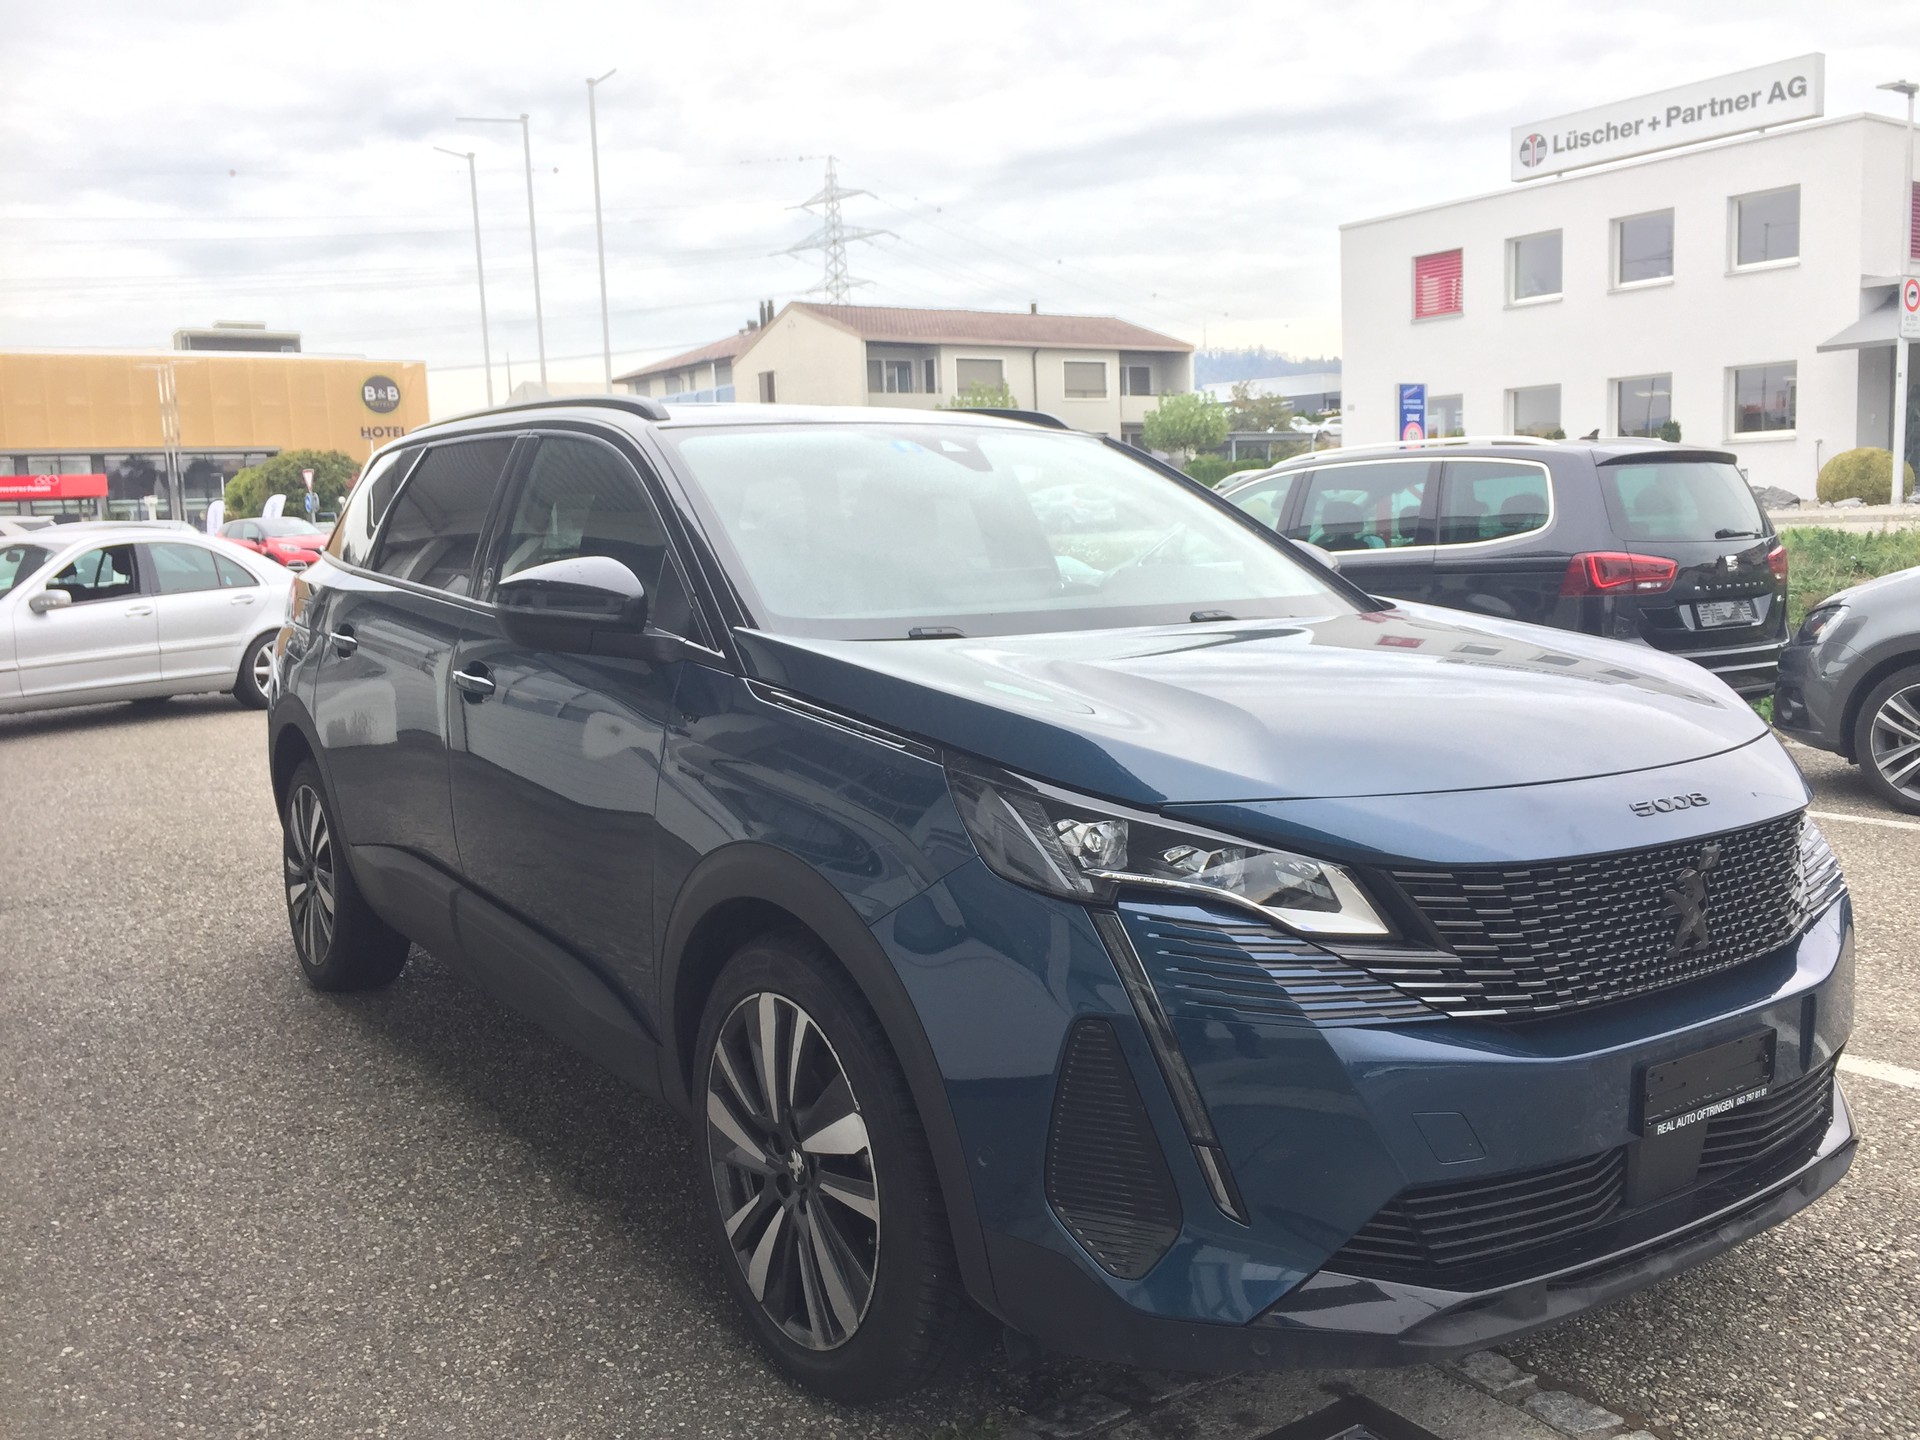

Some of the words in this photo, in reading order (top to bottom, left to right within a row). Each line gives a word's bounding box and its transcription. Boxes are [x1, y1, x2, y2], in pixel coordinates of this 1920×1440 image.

[1553, 118, 1644, 154] Lüscher
[1647, 115, 1662, 132] +
[1666, 90, 1762, 128] Partner
[1767, 75, 1808, 105] AG
[364, 385, 399, 402] B&B
[1629, 791, 1711, 817] 5008
[1657, 1122, 1676, 1135] REAL
[1676, 1112, 1696, 1129] AUTO
[1697, 1099, 1734, 1121] OFTRINGEN
